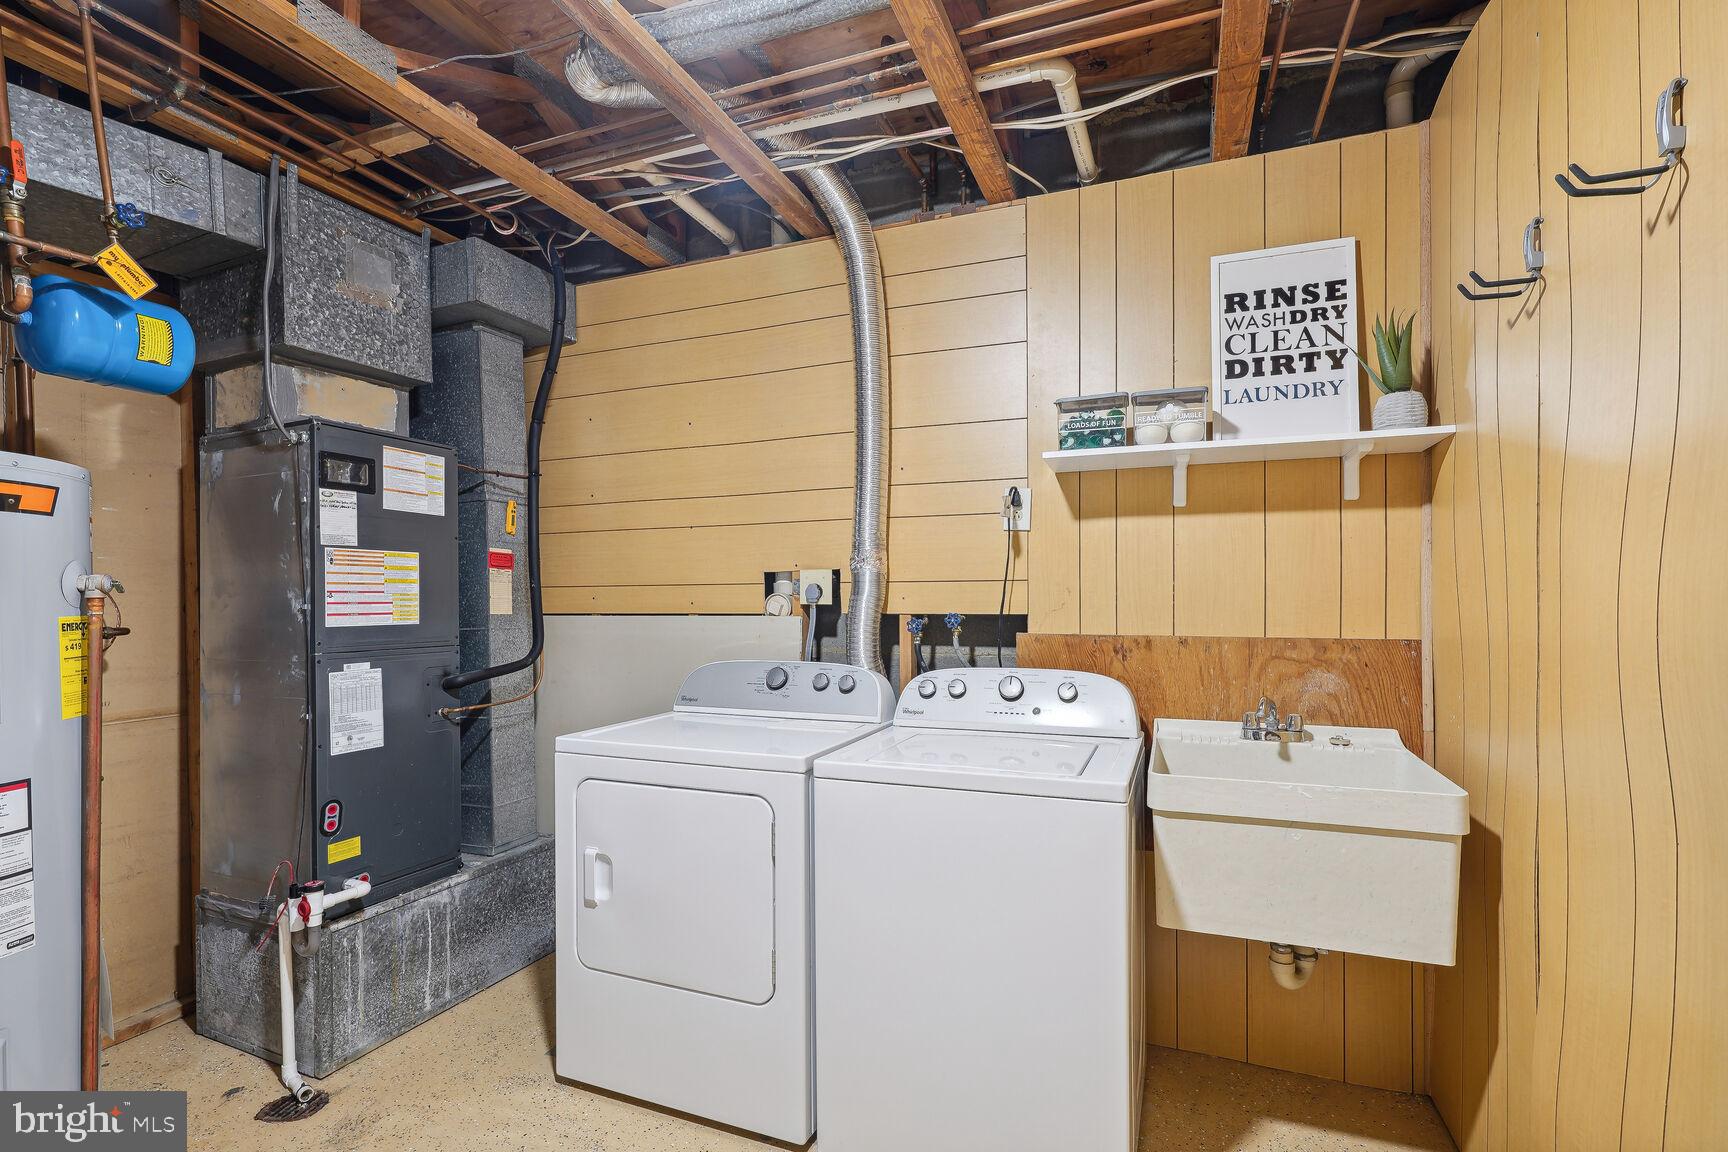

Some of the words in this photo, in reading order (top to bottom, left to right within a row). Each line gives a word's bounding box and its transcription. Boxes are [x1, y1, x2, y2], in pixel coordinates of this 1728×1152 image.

[120, 262, 147, 288] plumber
[1223, 278, 1348, 314] RINSE
[1224, 311, 1287, 332] WASH
[1289, 303, 1348, 325] DRY
[1224, 321, 1348, 356] CLEAN
[1224, 348, 1349, 380] DIRTY
[1223, 379, 1344, 405] LAUNDRY
[1067, 421, 1090, 429] LOADS
[1102, 419, 1116, 427] FUN
[1175, 410, 1203, 420] TUMBLE
[902, 707, 925, 715] Whirlpool
